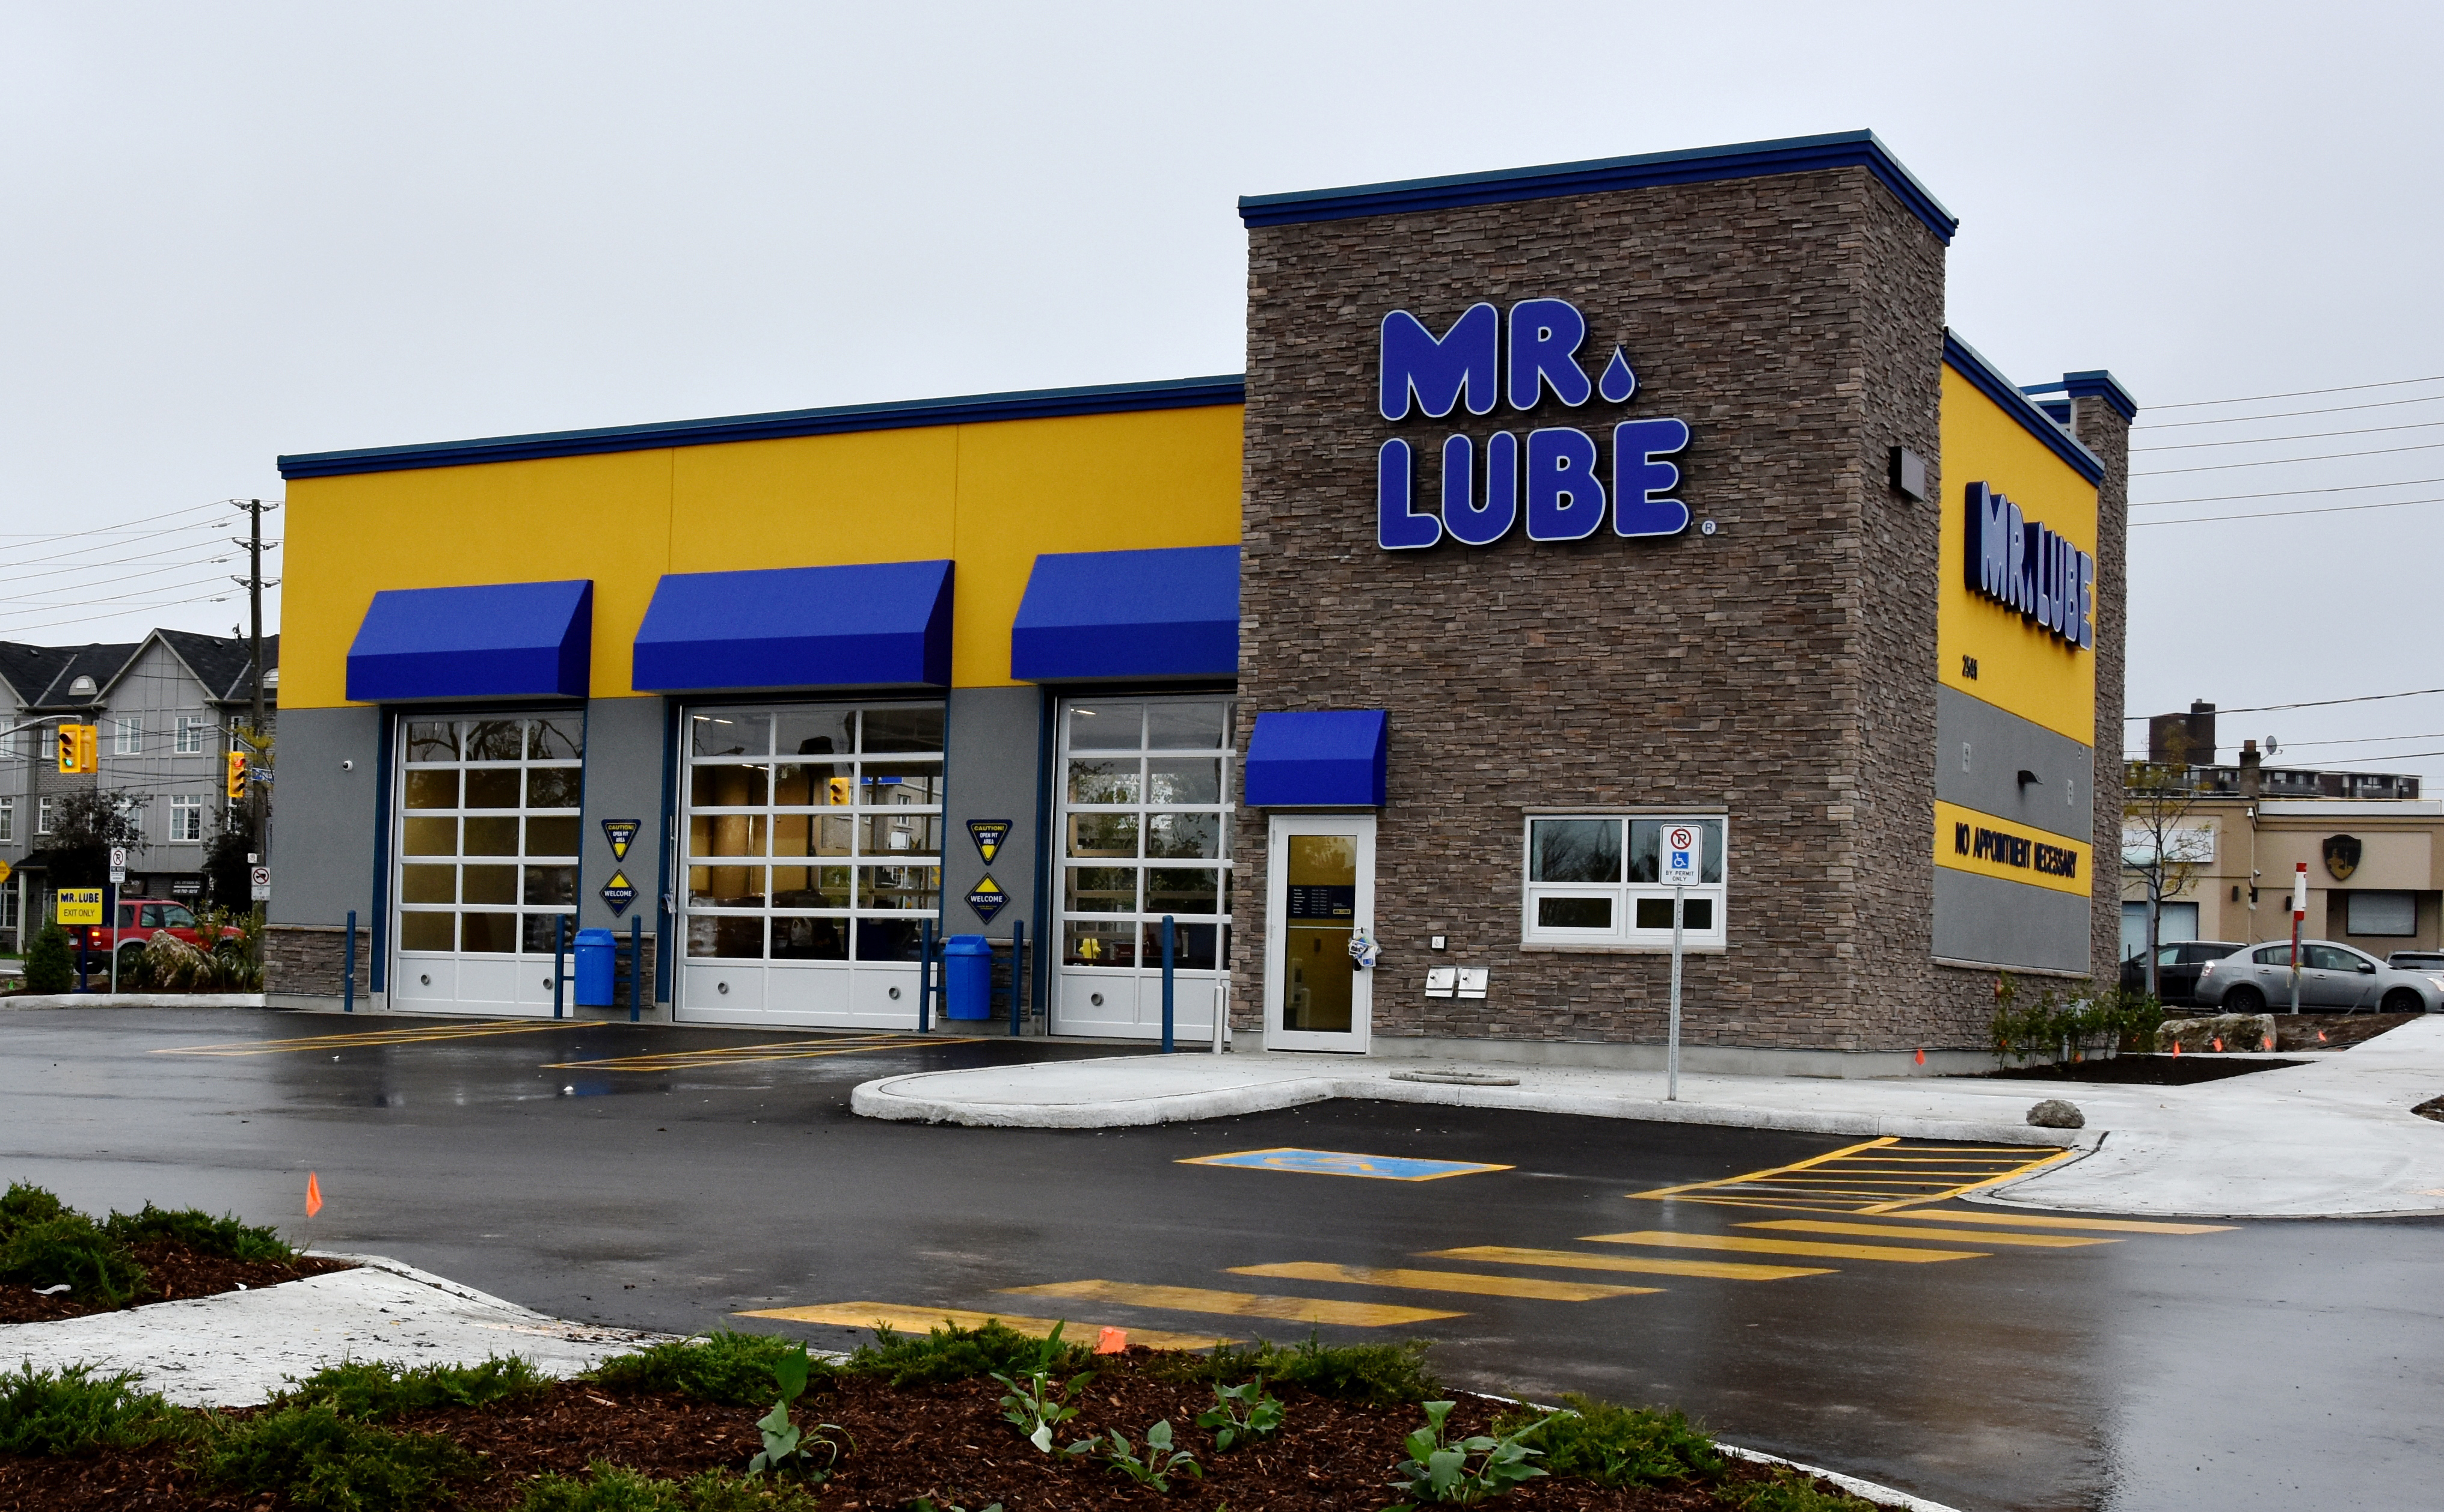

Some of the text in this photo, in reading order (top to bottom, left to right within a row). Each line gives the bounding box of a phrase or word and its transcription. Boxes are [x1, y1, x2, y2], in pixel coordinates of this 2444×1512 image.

[1378, 417, 1690, 549] LUBE
[2036, 521, 2093, 651] LUBE
[1955, 821, 2078, 879] NO APPOINTMENT NECESSARY
[61, 892, 99, 903] MR. LUBE
[64, 908, 95, 917] EXIT ONLY
